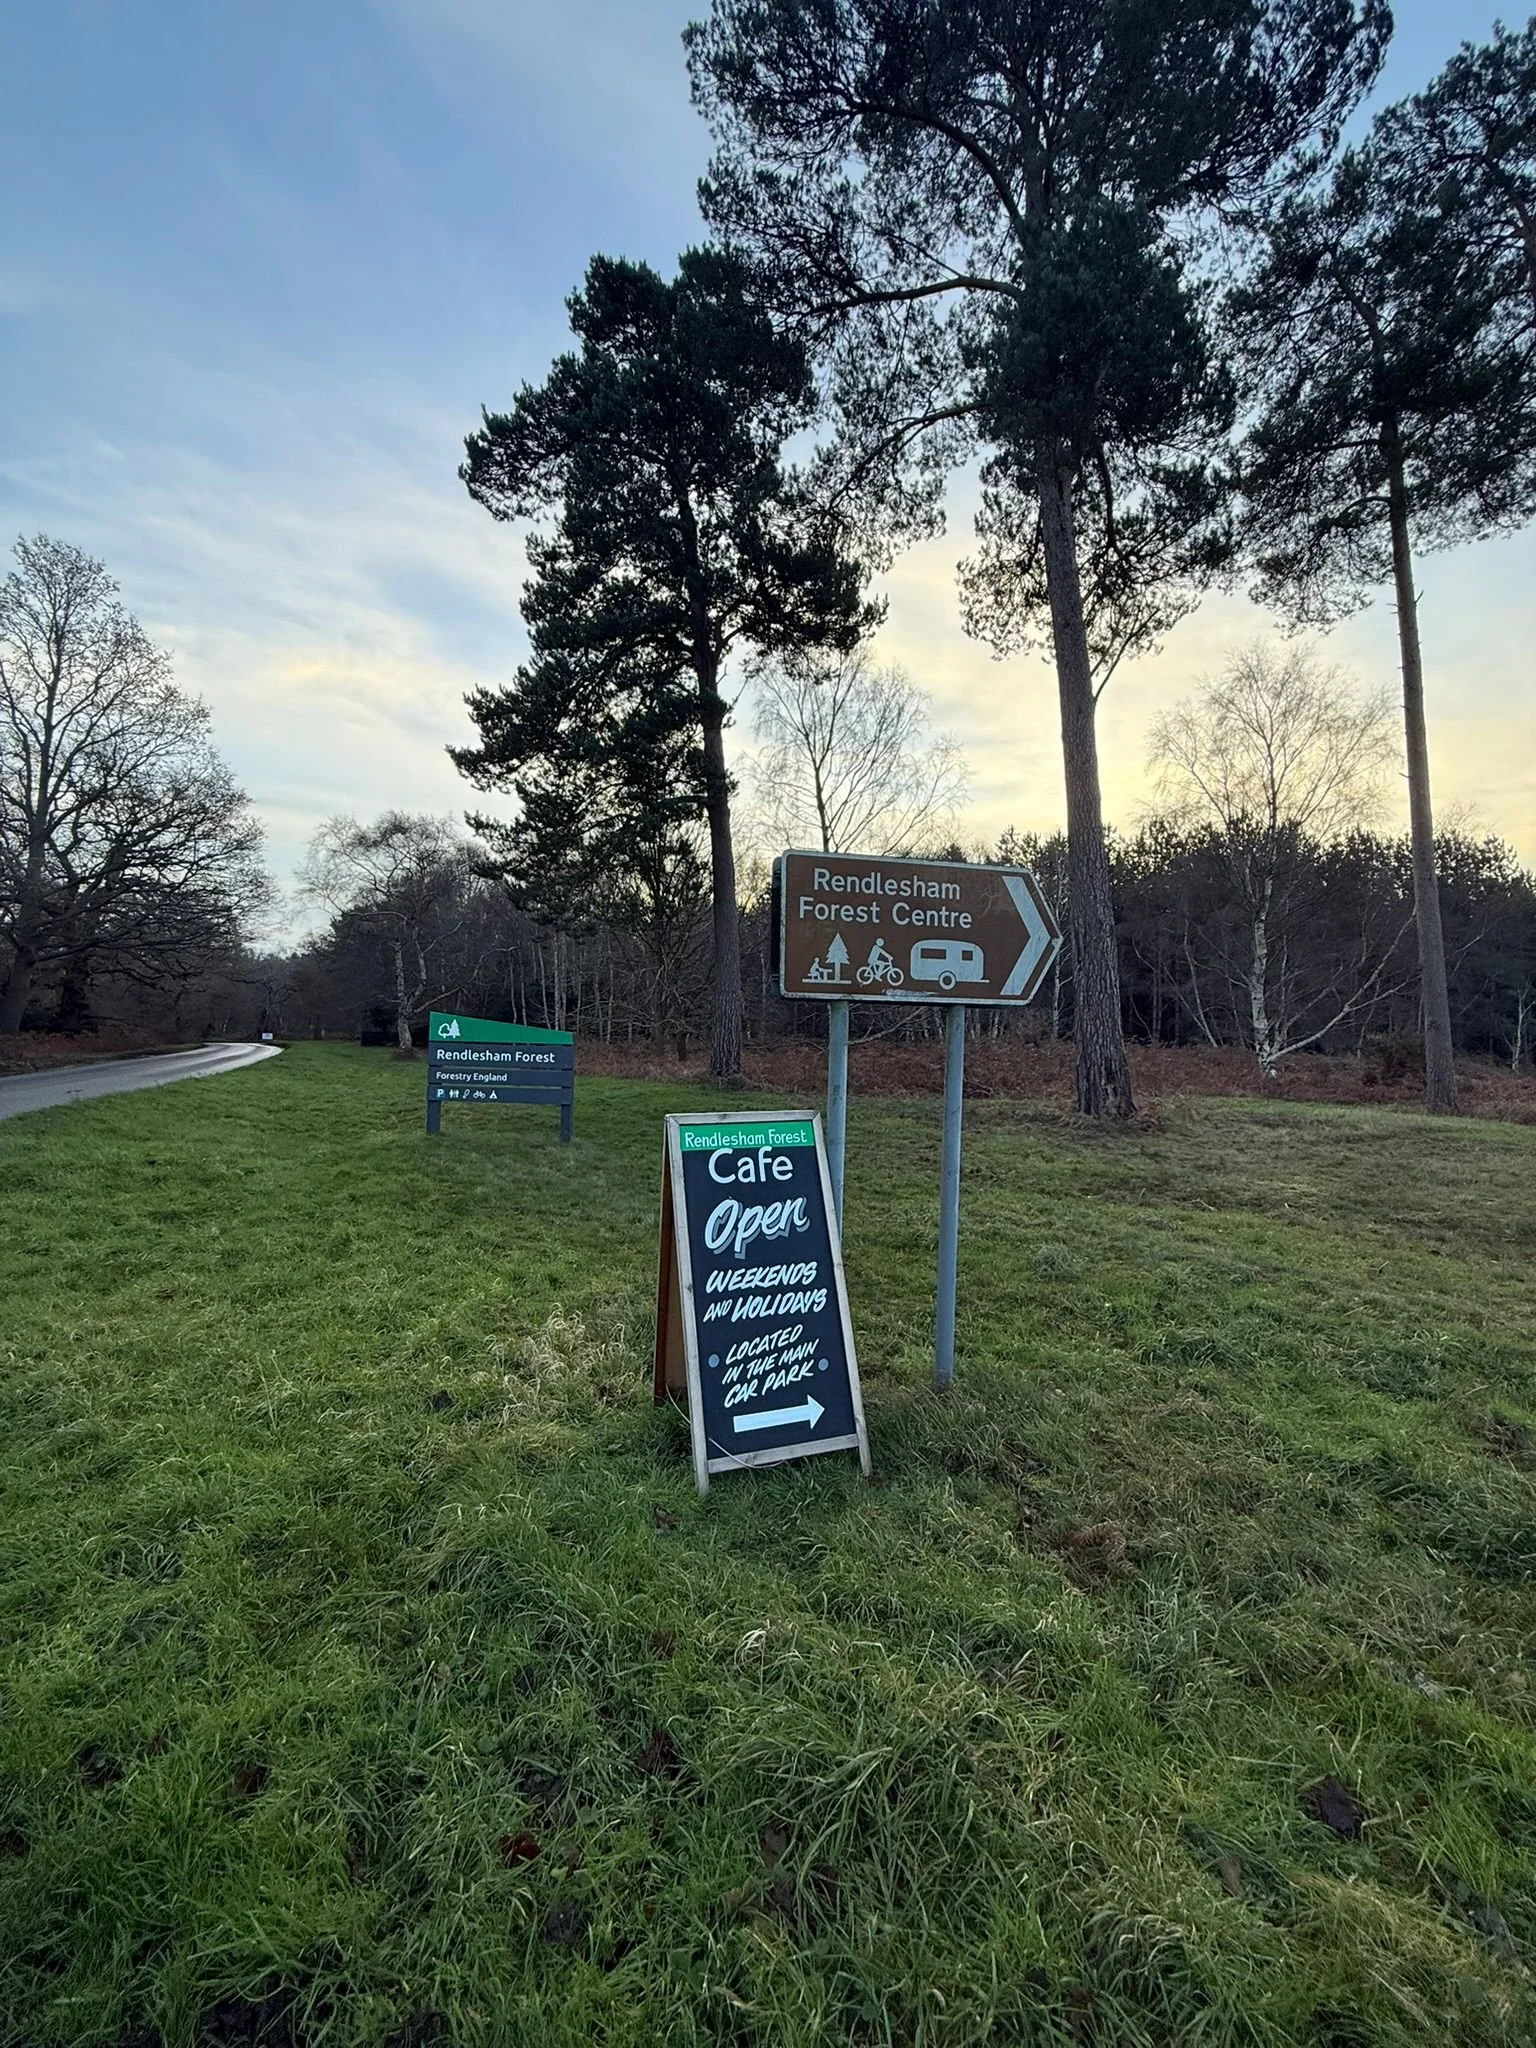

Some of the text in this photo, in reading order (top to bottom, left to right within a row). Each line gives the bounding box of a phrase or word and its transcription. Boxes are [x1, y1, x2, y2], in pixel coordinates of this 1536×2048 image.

[813, 867, 961, 900] Rendlesham
[799, 896, 972, 928] Forest Centre
[437, 1049, 556, 1063] Rendlesham Forest
[436, 1072, 508, 1082] Forestry England
[685, 1129, 807, 1148] Rendlesham Forest
[708, 1146, 794, 1184] Cafe
[704, 1197, 810, 1260] Open
[705, 1261, 818, 1294] WEEKENDS
[703, 1288, 828, 1323] AND HOLIDAYS
[722, 1338, 820, 1385] IN THE MAIN
[725, 1324, 803, 1365] LOCATED
[724, 1359, 814, 1409] CAR PARK
